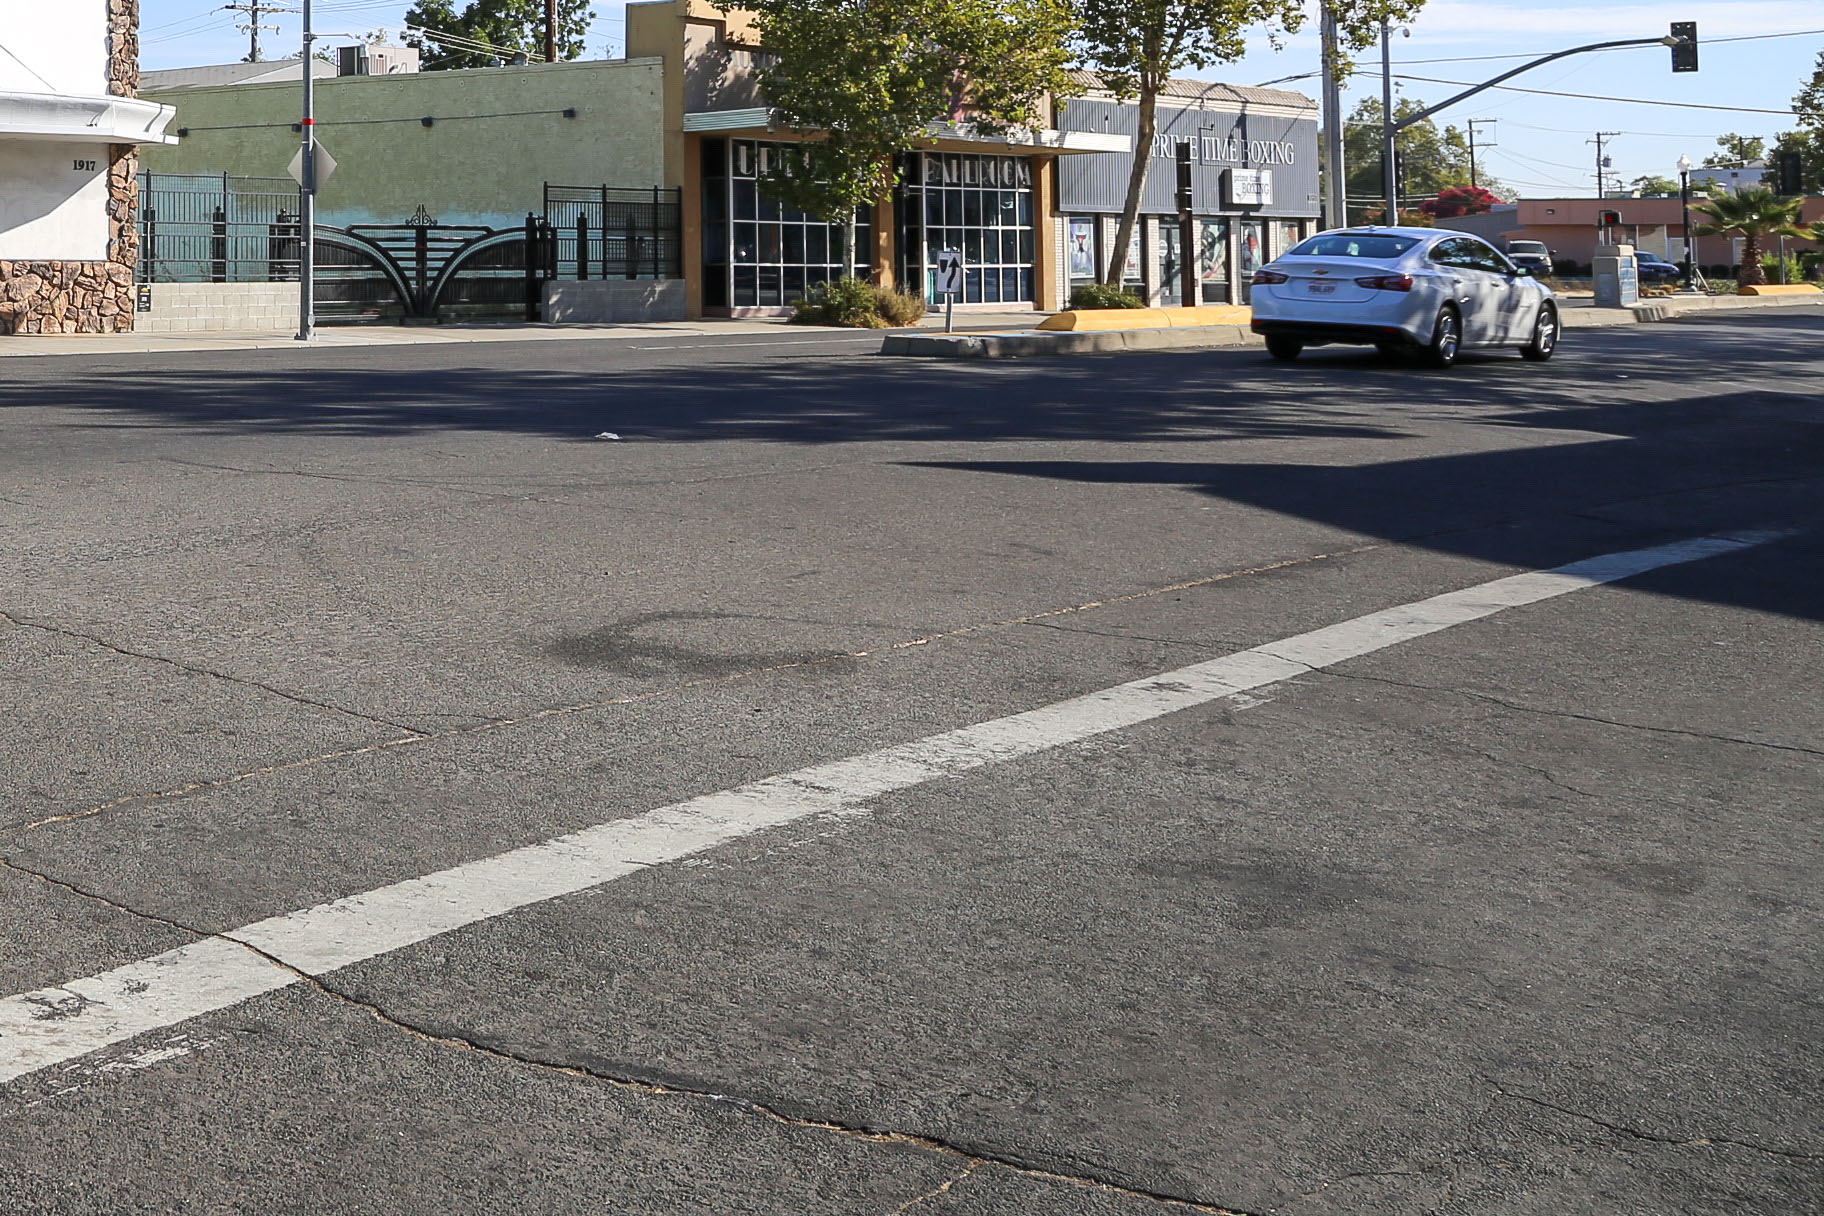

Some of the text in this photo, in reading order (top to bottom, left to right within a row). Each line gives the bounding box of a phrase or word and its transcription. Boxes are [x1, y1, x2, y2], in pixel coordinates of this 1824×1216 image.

[1152, 133, 1295, 165] PRIE TIME BOXING
[73, 159, 96, 172] 1917
[924, 157, 1032, 186] BALLROOM
[1241, 182, 1270, 195] BOXING
